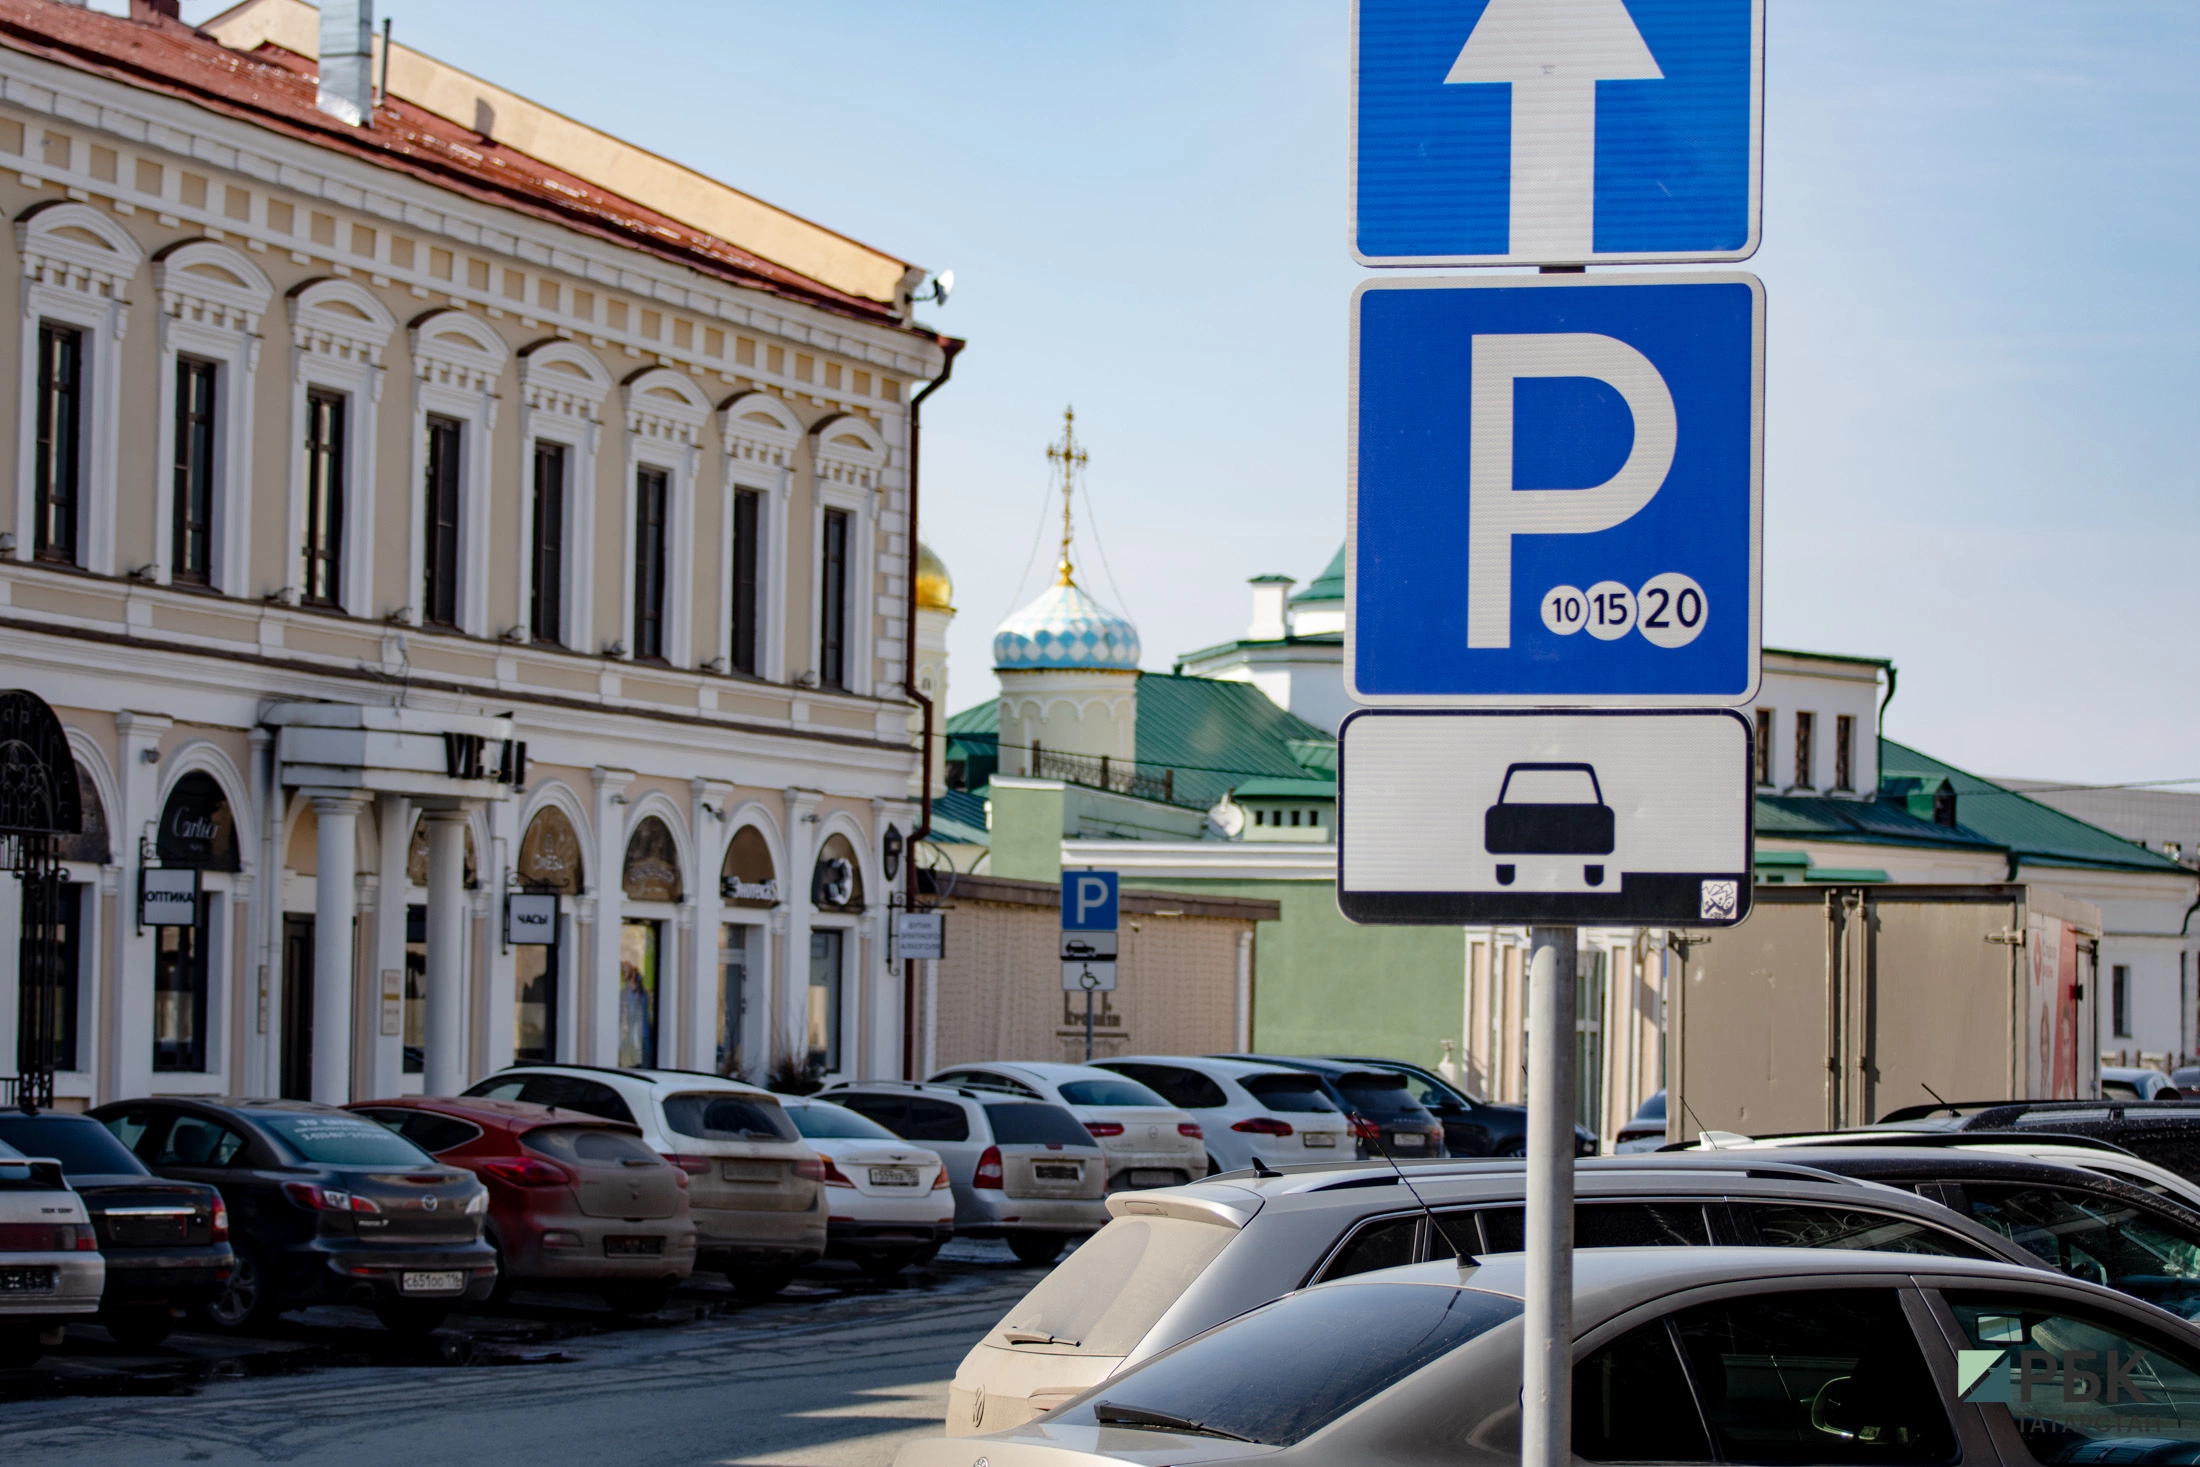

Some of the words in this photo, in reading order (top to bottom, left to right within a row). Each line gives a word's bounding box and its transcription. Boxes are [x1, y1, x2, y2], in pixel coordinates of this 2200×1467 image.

[1467, 332, 1678, 649] P
[1552, 597, 1581, 624] 10
[1592, 592, 1629, 626] 15
[1644, 588, 1701, 628] 20
[145, 891, 194, 903] ОПТИКА
[1077, 877, 1109, 924] P
[518, 914, 548, 925] ЧАСЫ
